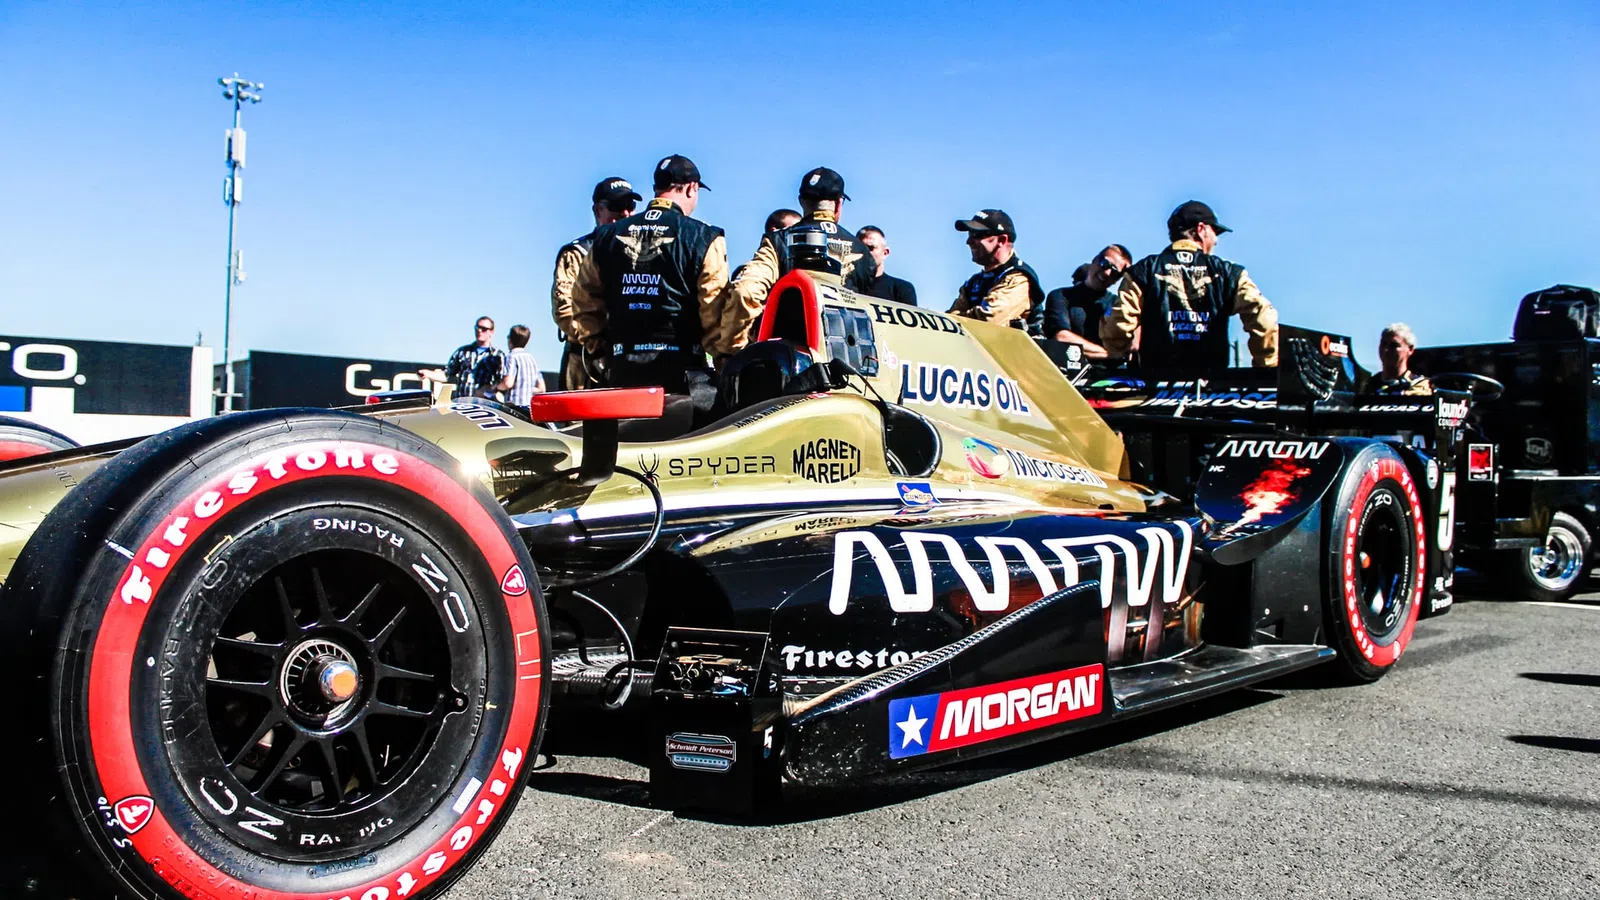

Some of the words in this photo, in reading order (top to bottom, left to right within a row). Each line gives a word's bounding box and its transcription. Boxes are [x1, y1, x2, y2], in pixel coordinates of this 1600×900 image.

[622, 273, 661, 285] ARROW
[622, 286, 645, 295] LUCAS
[646, 287, 659, 296] OIL
[902, 362, 991, 408] LUCAS
[998, 373, 1029, 414] OIL
[793, 438, 861, 474] MAGNETI
[1216, 440, 1330, 459] ARROW
[669, 456, 776, 477] SPYDER
[120, 447, 400, 605] Firestone
[312, 517, 405, 548] RACING
[829, 520, 1193, 616] ARROW
[939, 674, 1097, 741] MORGAN
[668, 743, 698, 752] Schmidt
[699, 746, 733, 756] Peterson
